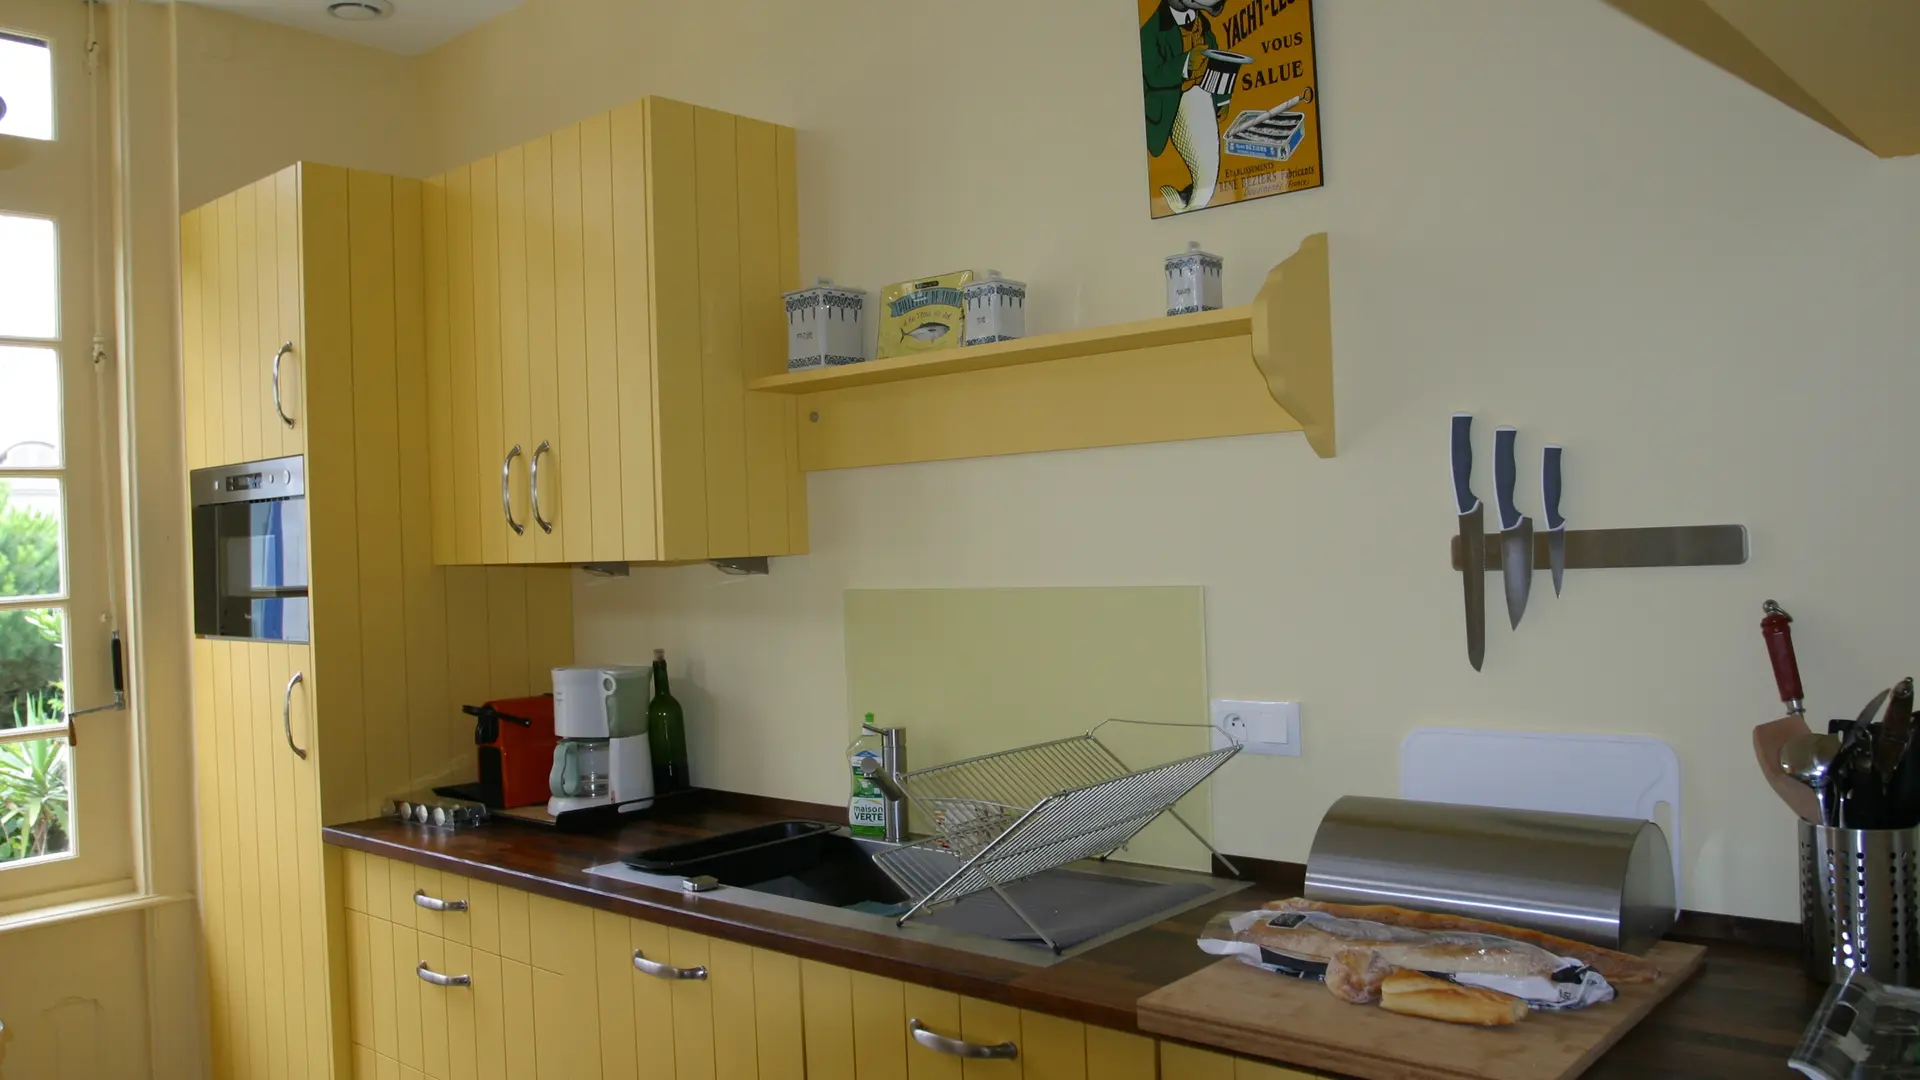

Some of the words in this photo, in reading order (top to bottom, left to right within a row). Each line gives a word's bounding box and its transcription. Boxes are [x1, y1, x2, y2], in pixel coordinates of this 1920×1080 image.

[1222, 0, 1297, 50] YACHT-C
[1261, 32, 1303, 53] VOUS
[1242, 60, 1304, 91] SALUE
[853, 804, 883, 813] maison
[854, 812, 883, 823] VERTE
